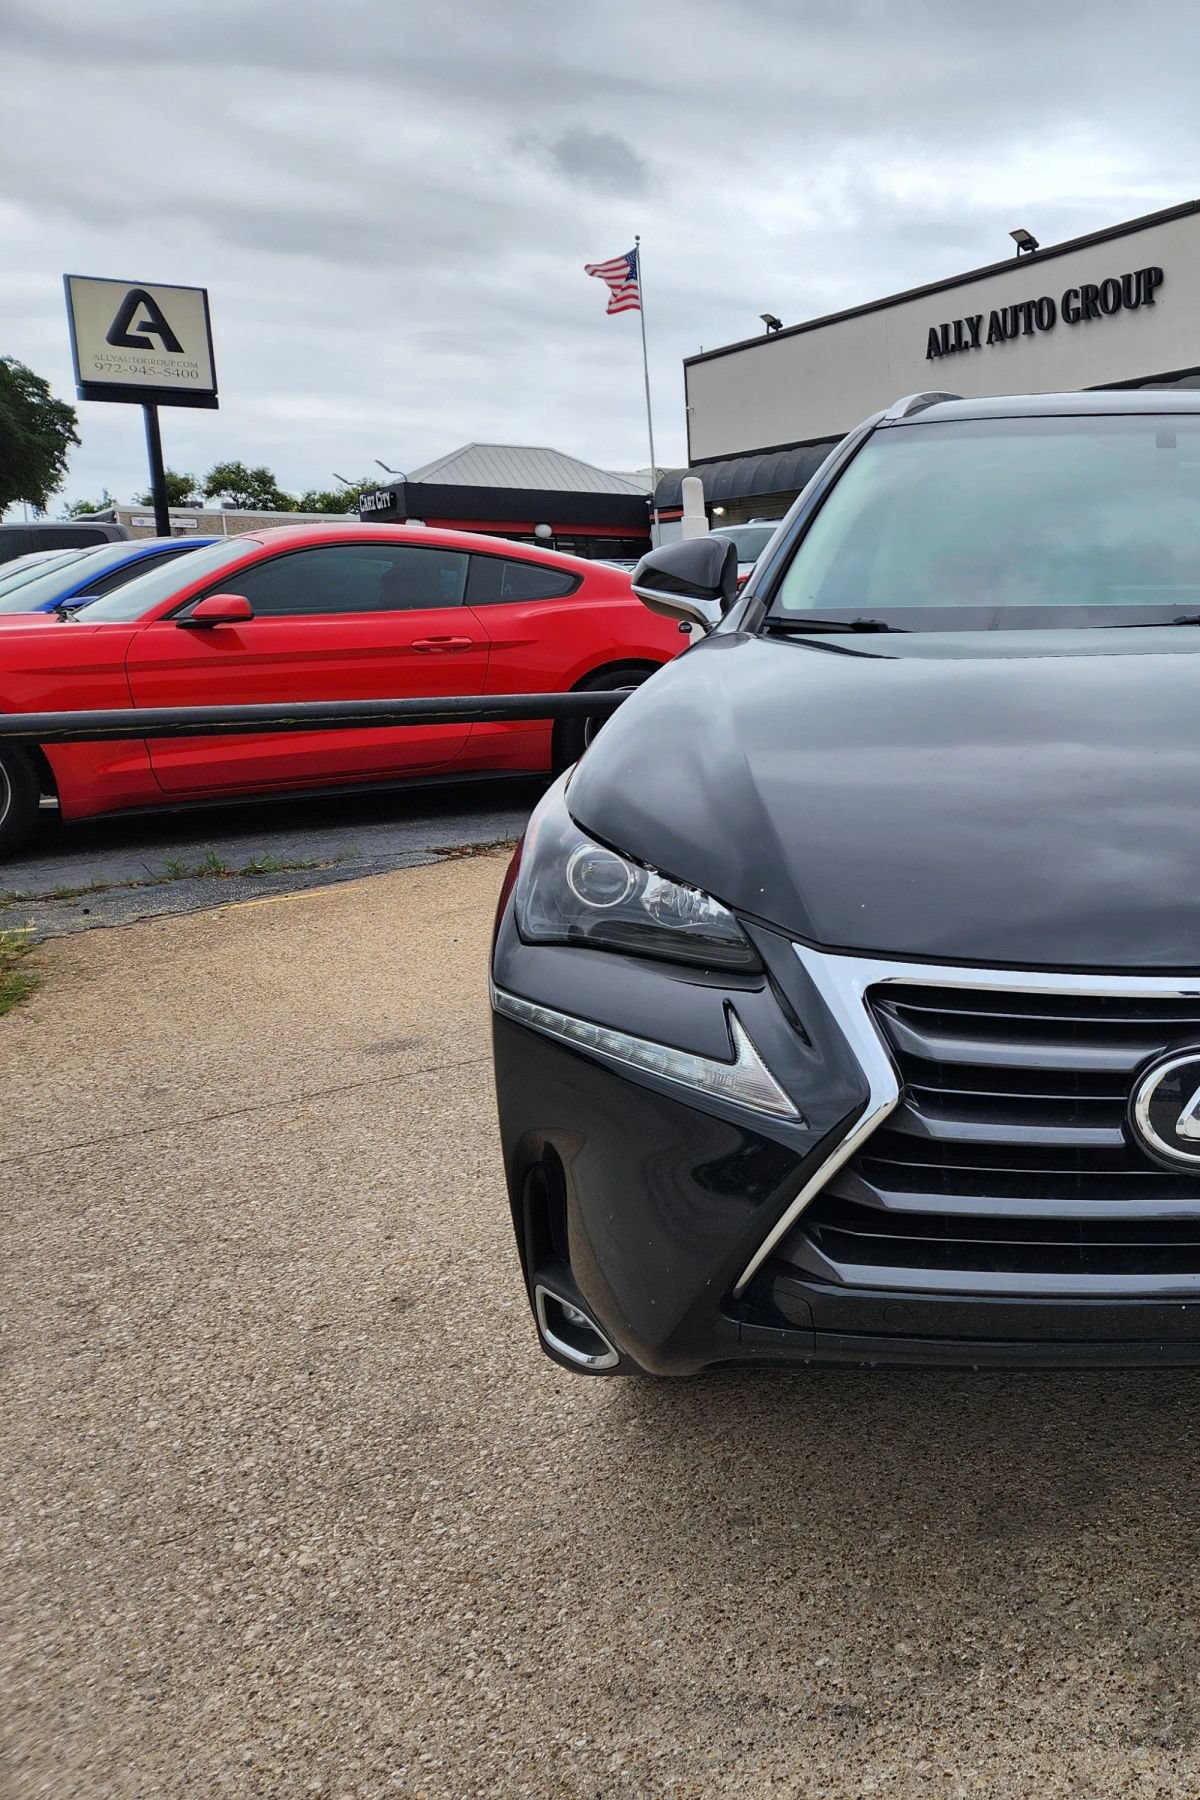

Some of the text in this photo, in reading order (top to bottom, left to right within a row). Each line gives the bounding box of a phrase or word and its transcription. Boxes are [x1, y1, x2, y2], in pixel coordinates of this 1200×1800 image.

[925, 266, 1164, 360] ALLY AUTO GROUP
[93, 353, 199, 369] ALLYAUTOGROUP.COM
[94, 361, 199, 379] 972-945-5400
